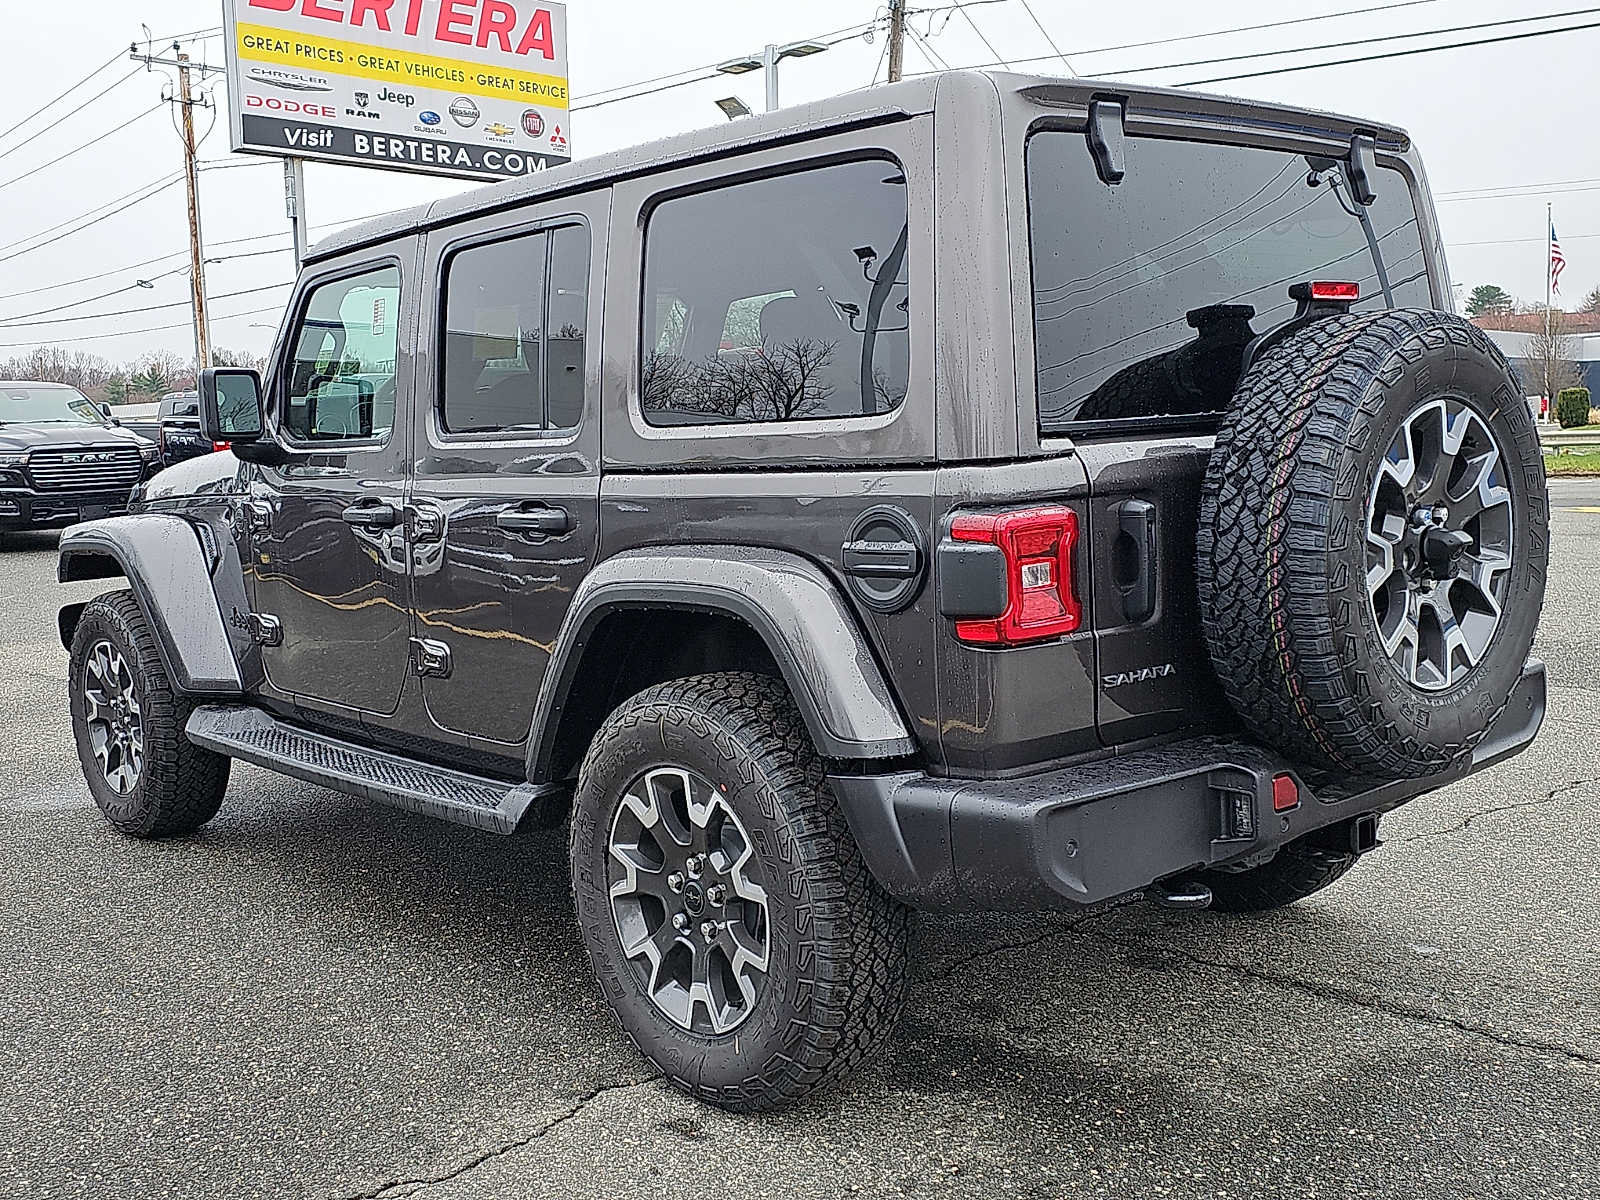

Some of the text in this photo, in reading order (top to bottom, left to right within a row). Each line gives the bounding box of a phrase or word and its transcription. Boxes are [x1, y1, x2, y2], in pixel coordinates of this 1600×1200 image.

[243, 35, 566, 99] GREAT PRICES GREAT VEHICLES GREAT SERVICE
[250, 68, 328, 85] CHRYSLER
[246, 95, 337, 118] DODGE
[377, 87, 415, 107] Jeep
[345, 108, 380, 119] RAM
[451, 107, 478, 117] NISSAN
[414, 126, 447, 135] SUBARU
[284, 127, 547, 174] Visit BERTERA.COM
[1102, 664, 1176, 688] SAHARA
